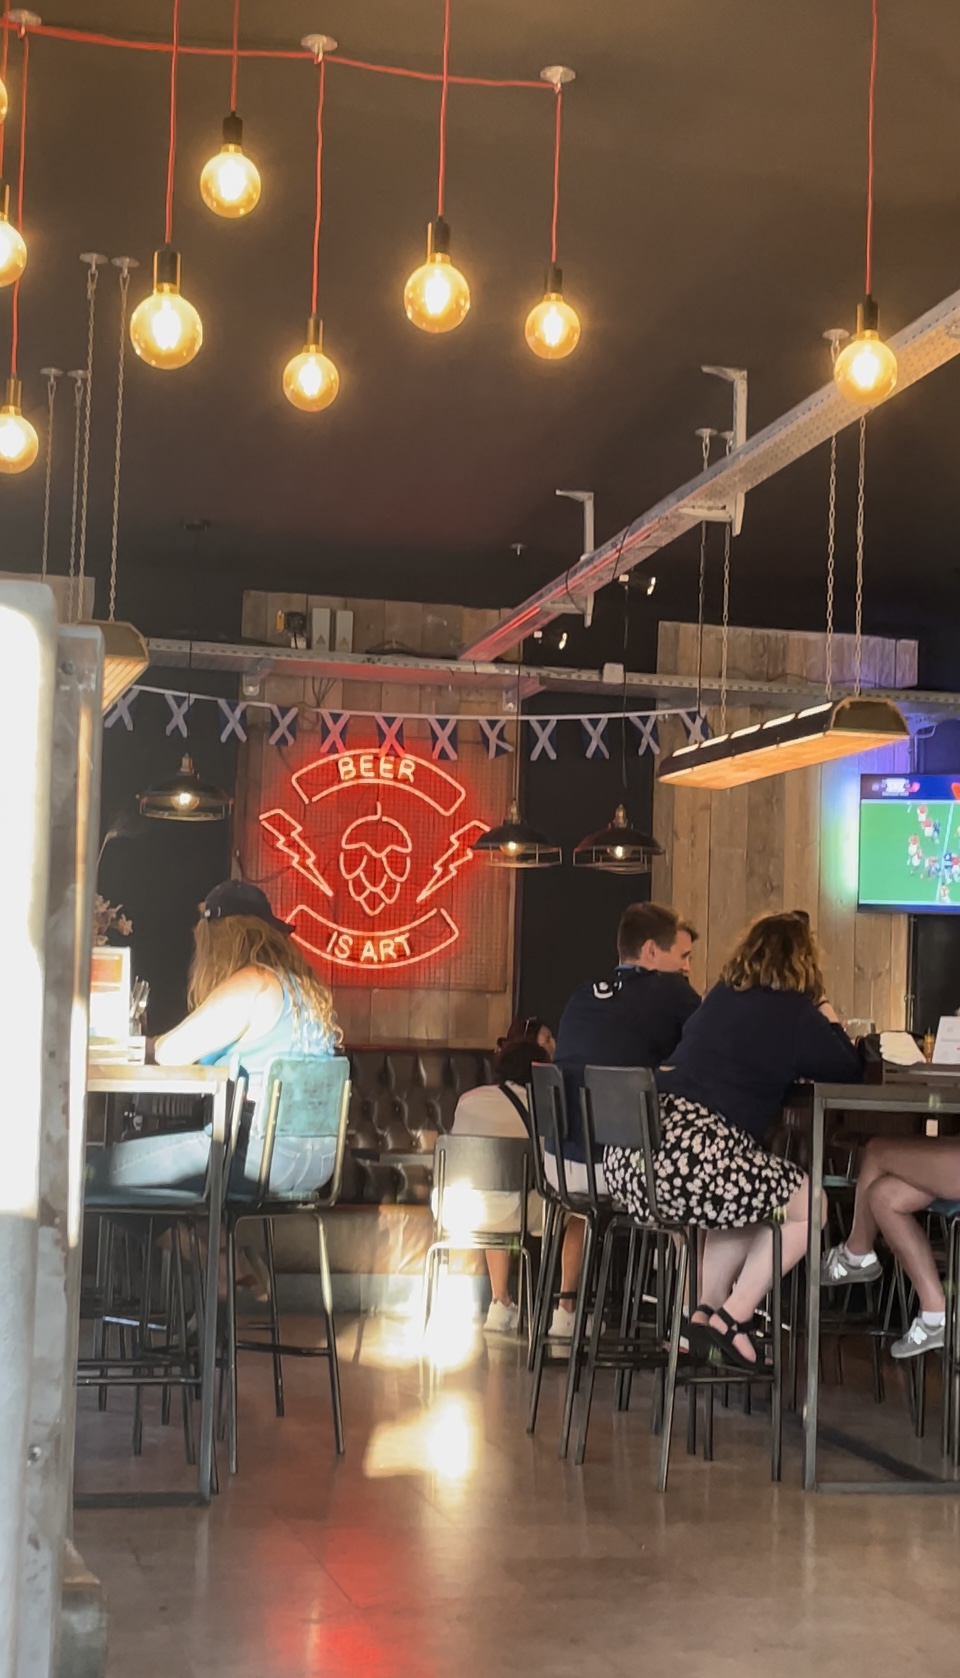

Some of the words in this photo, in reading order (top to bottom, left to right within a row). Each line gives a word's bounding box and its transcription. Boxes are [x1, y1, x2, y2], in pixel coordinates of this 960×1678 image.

[337, 755, 416, 783] BEER
[326, 931, 353, 959] IS
[360, 933, 411, 963] ART
